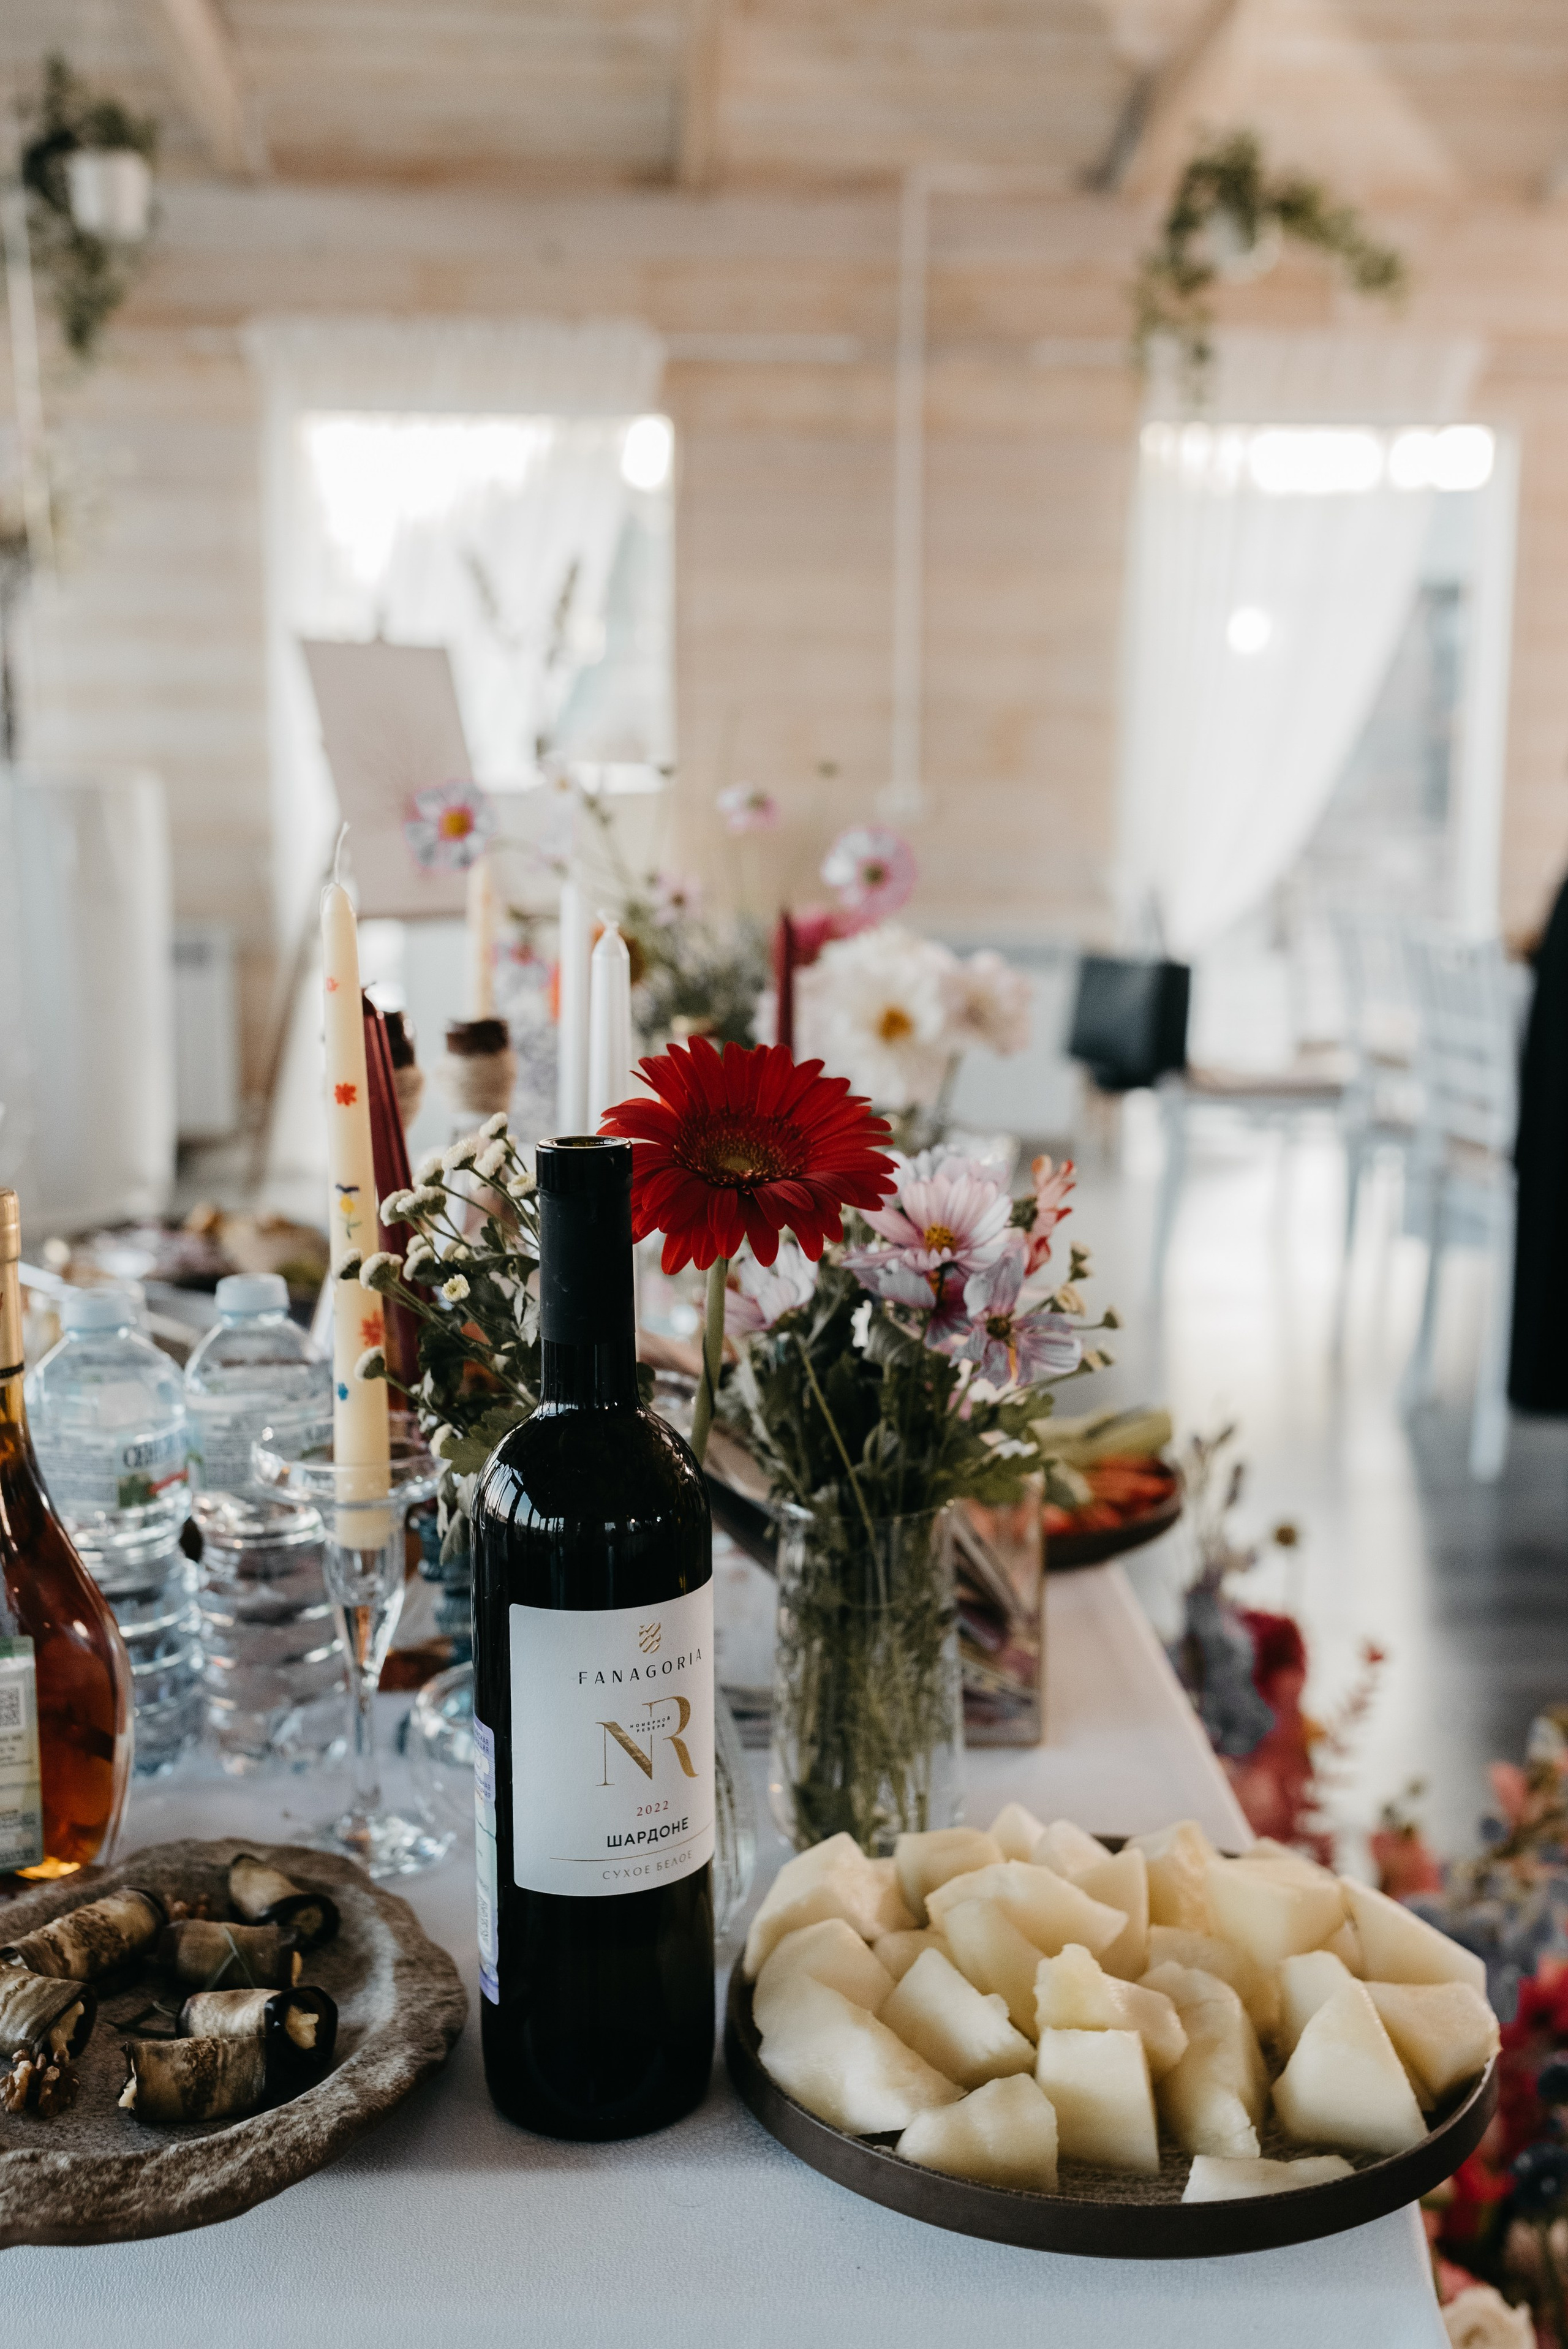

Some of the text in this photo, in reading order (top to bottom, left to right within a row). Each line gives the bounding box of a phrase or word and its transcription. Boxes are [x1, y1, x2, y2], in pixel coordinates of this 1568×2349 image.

[579, 1648, 701, 1684] FANAGORIA
[630, 1716, 671, 1729] НОМЕРНОЙ
[636, 1723, 665, 1733] РЕЗЕРВ
[636, 1800, 669, 1817] 2022
[607, 1817, 689, 1847] ШАРДОНЕ
[602, 1850, 693, 1880] СУХОЕ БЕЛОЕ
